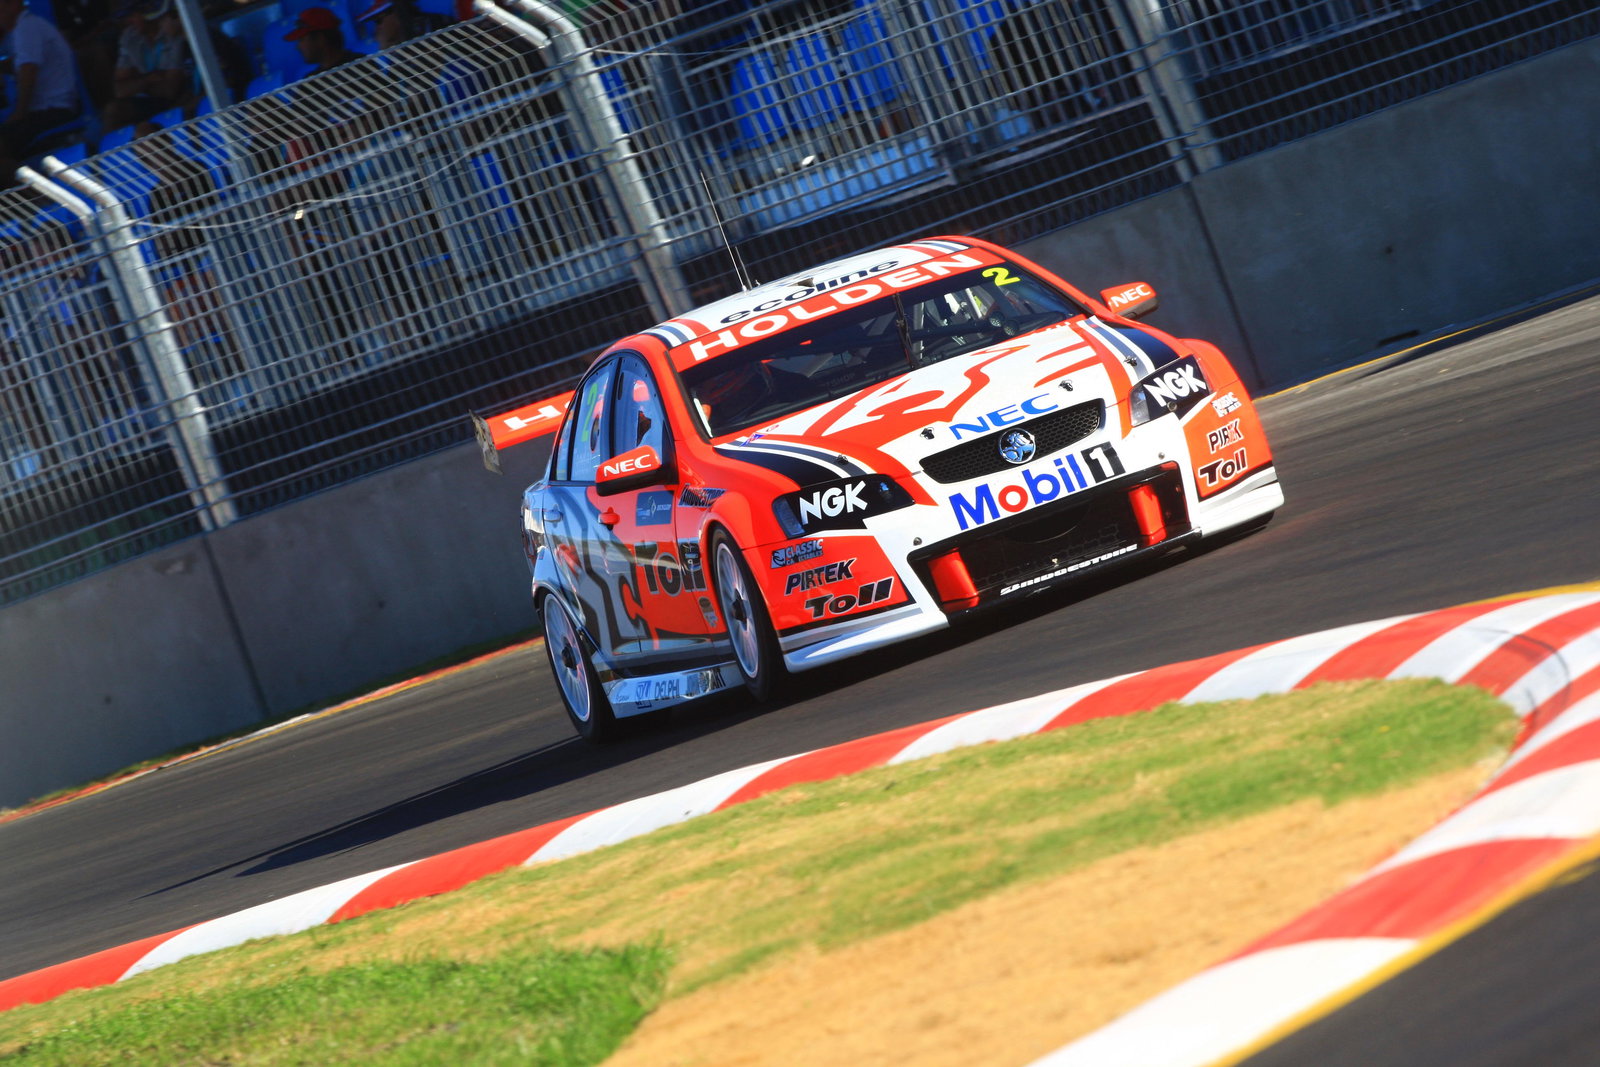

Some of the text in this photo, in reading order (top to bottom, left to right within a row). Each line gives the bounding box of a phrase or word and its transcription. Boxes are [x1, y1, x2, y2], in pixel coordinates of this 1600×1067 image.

[720, 261, 900, 324] ecoline
[982, 267, 1021, 286] 2
[1110, 284, 1151, 308] NEC
[690, 254, 984, 361] HOLDEN
[1143, 364, 1206, 407] NGK
[503, 400, 570, 430] H
[949, 393, 1059, 440] NEC
[604, 454, 652, 476] NEC
[1199, 448, 1247, 485] Toll
[800, 480, 868, 525] NGK
[949, 443, 1118, 530] Mobil 1
[785, 539, 824, 558] CLASSIC
[785, 558, 857, 596] PIRTEK
[805, 576, 894, 619] Toll
